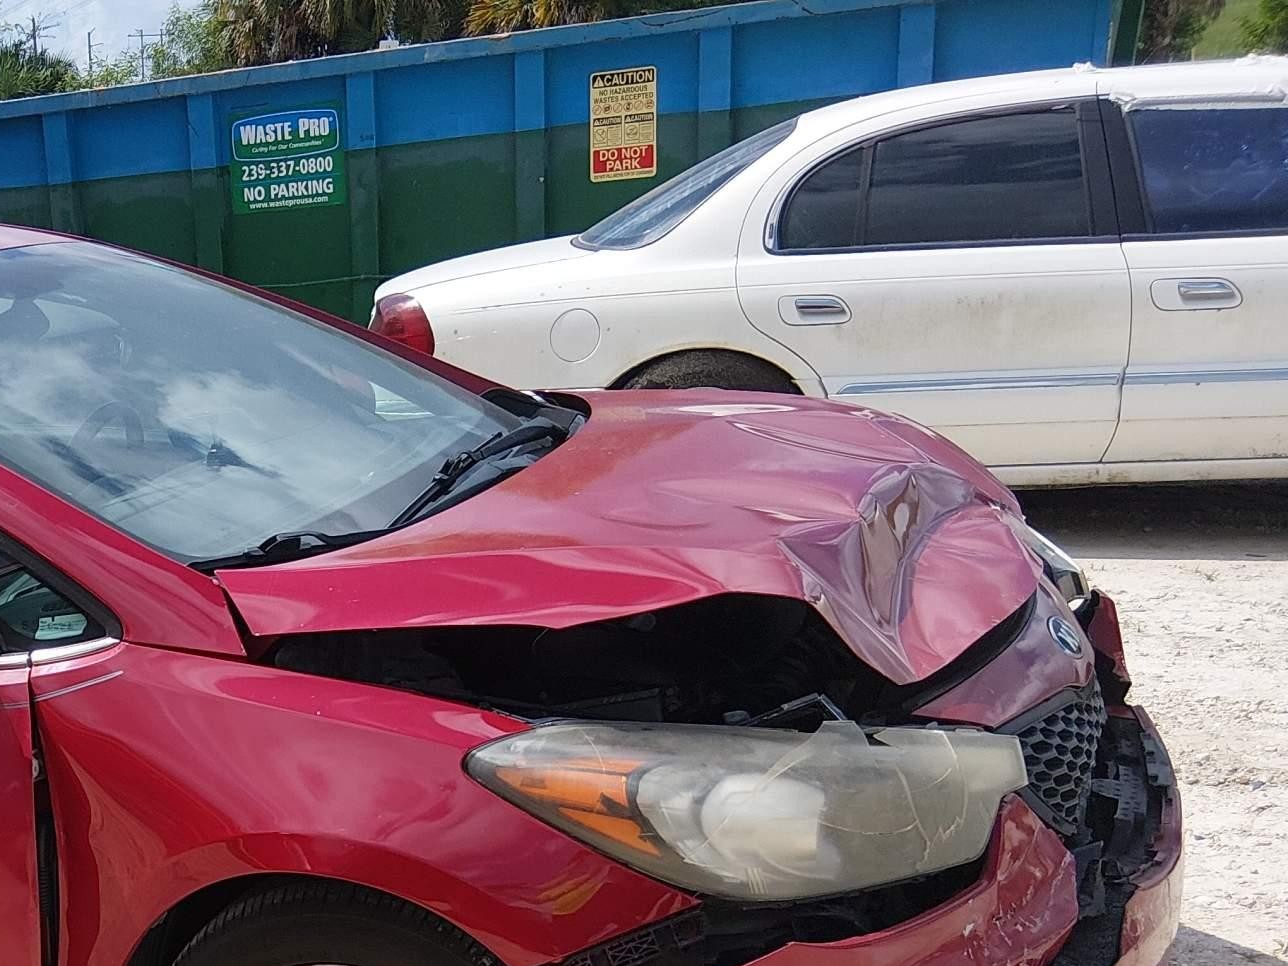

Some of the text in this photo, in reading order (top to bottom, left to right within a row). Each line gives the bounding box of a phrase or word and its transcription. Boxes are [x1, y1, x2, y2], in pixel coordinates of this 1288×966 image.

[604, 70, 653, 86] CAUTION
[594, 92, 654, 104] WASTES ACCEPTED
[598, 85, 648, 97] NO HAZARDOUS
[240, 117, 330, 146] WASTE PRO
[278, 142, 288, 150] Our
[600, 146, 649, 162] DO NOT
[242, 156, 333, 182] 239-337-0800
[606, 158, 641, 172] PARK
[243, 178, 334, 202] NO PARKING
[249, 196, 329, 210] www.wasteprousa.com
